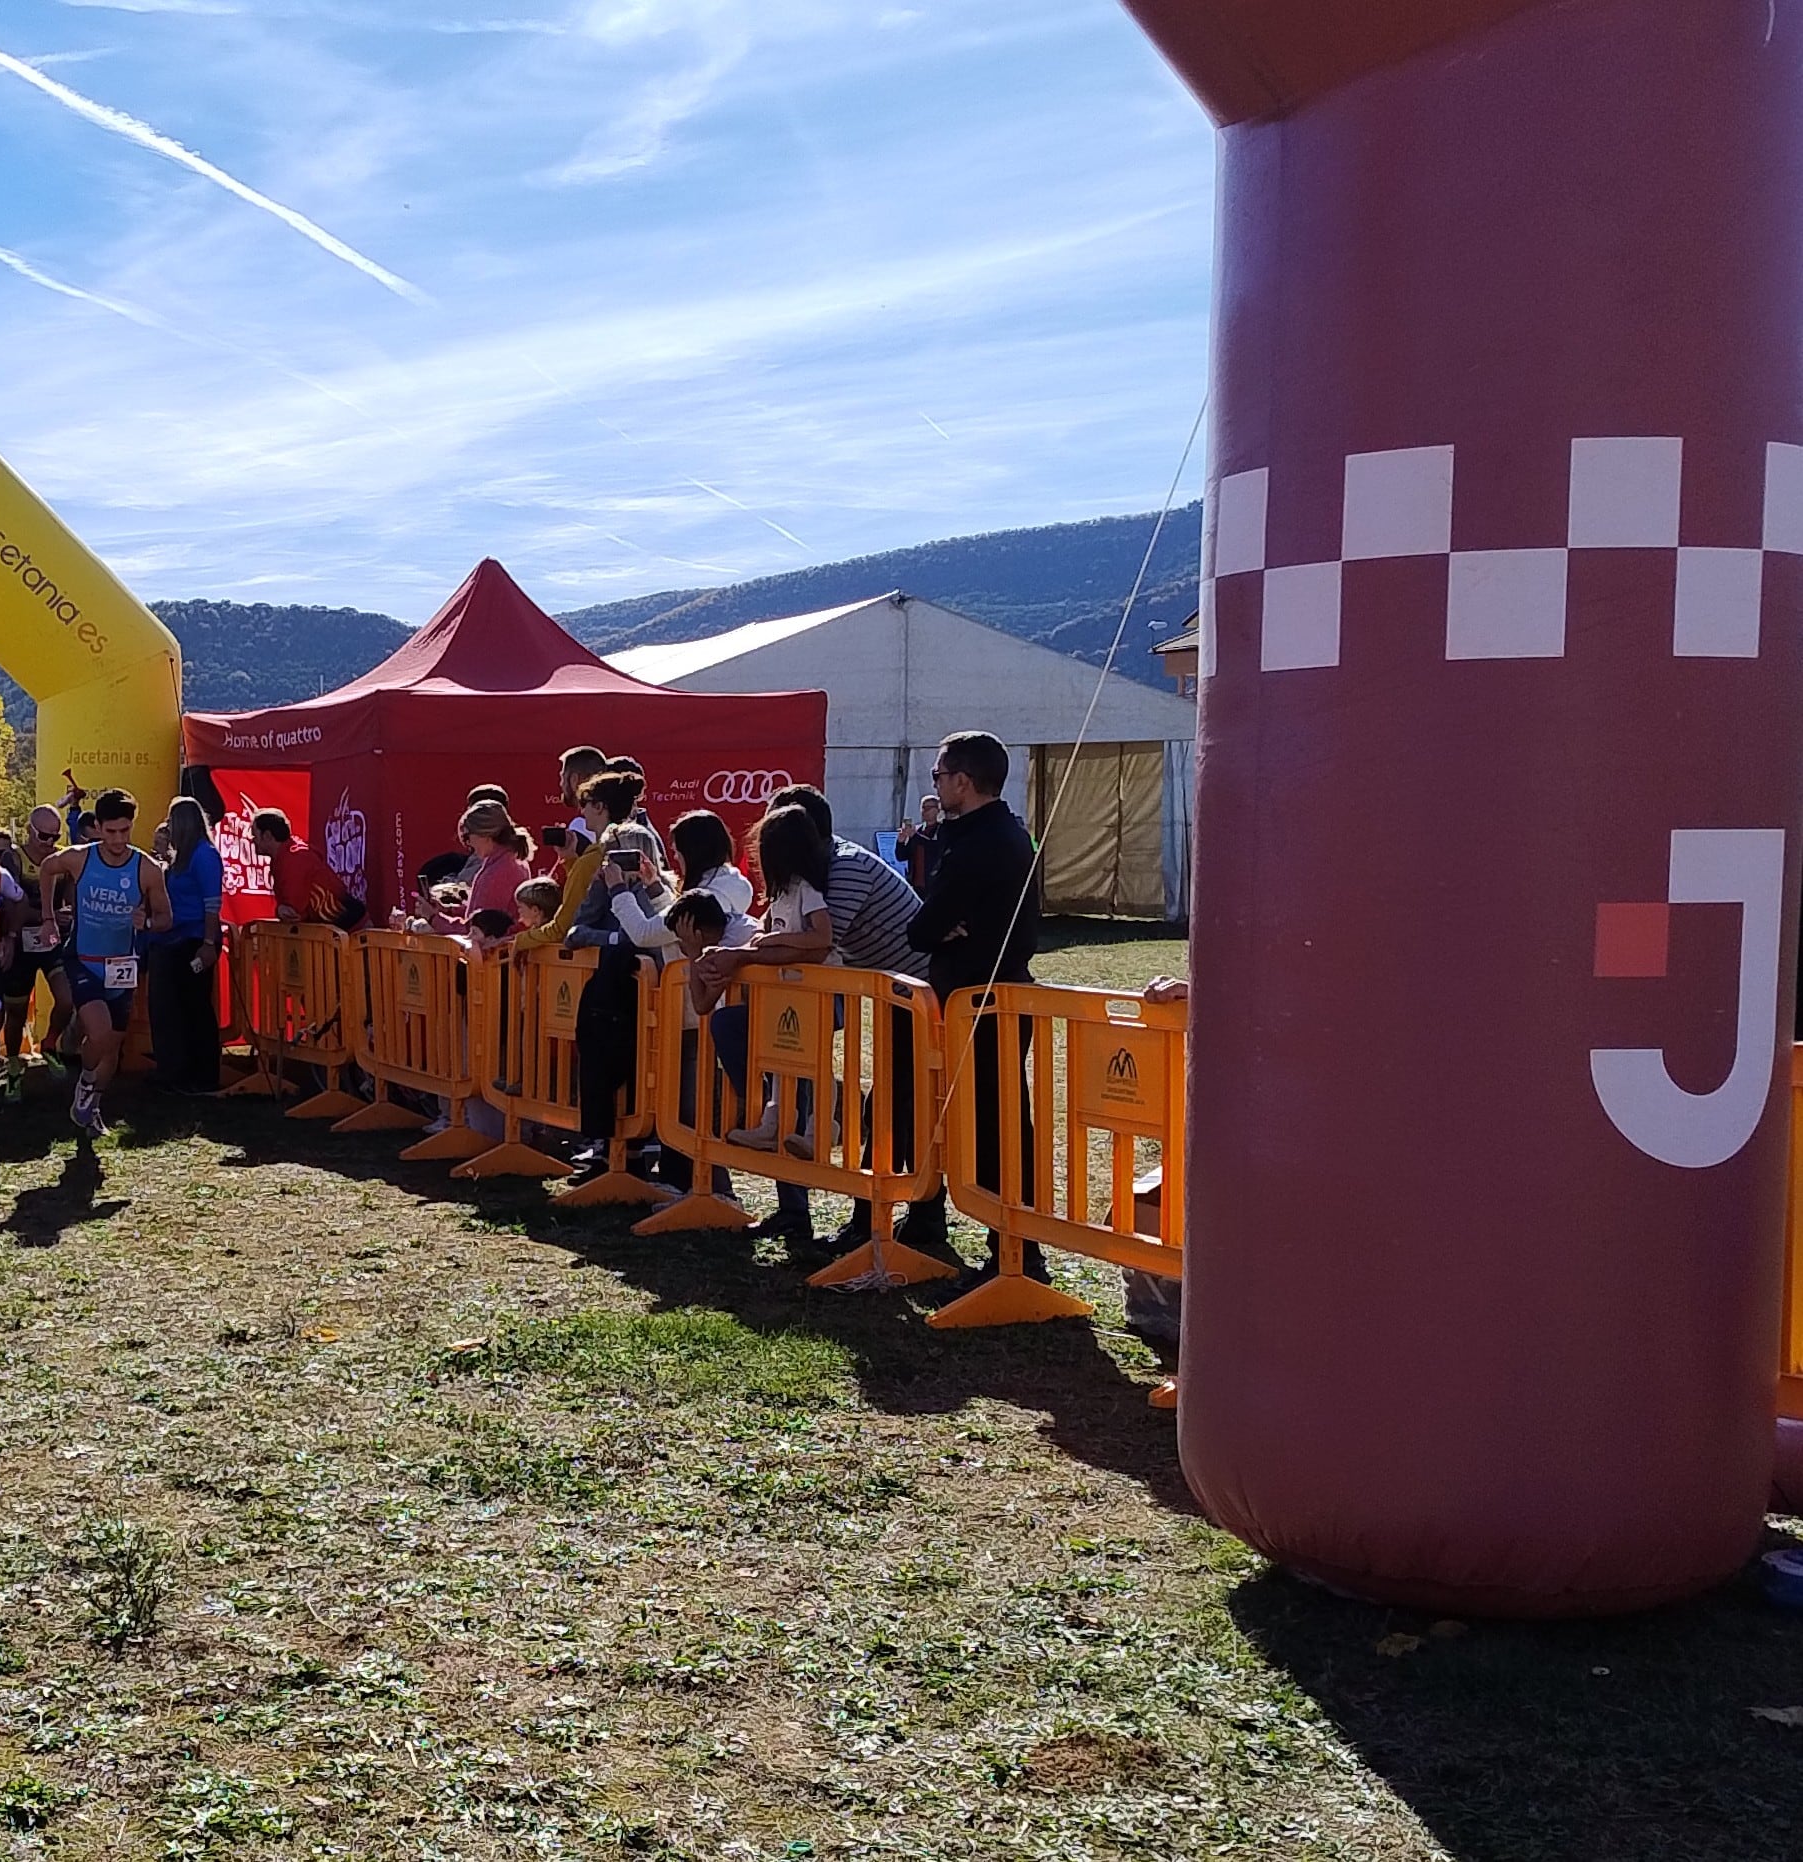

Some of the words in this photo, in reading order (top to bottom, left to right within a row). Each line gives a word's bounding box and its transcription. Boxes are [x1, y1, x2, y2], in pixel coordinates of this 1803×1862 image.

[223, 731, 259, 749] Home
[260, 729, 274, 749] of
[276, 726, 322, 752] quattro
[66, 747, 131, 765] Jacetania
[669, 779, 700, 790] Audi
[651, 791, 697, 802] Technik
[395, 811, 406, 911] ow-day.com
[89, 885, 128, 905] VERA
[116, 967, 133, 980] 27
